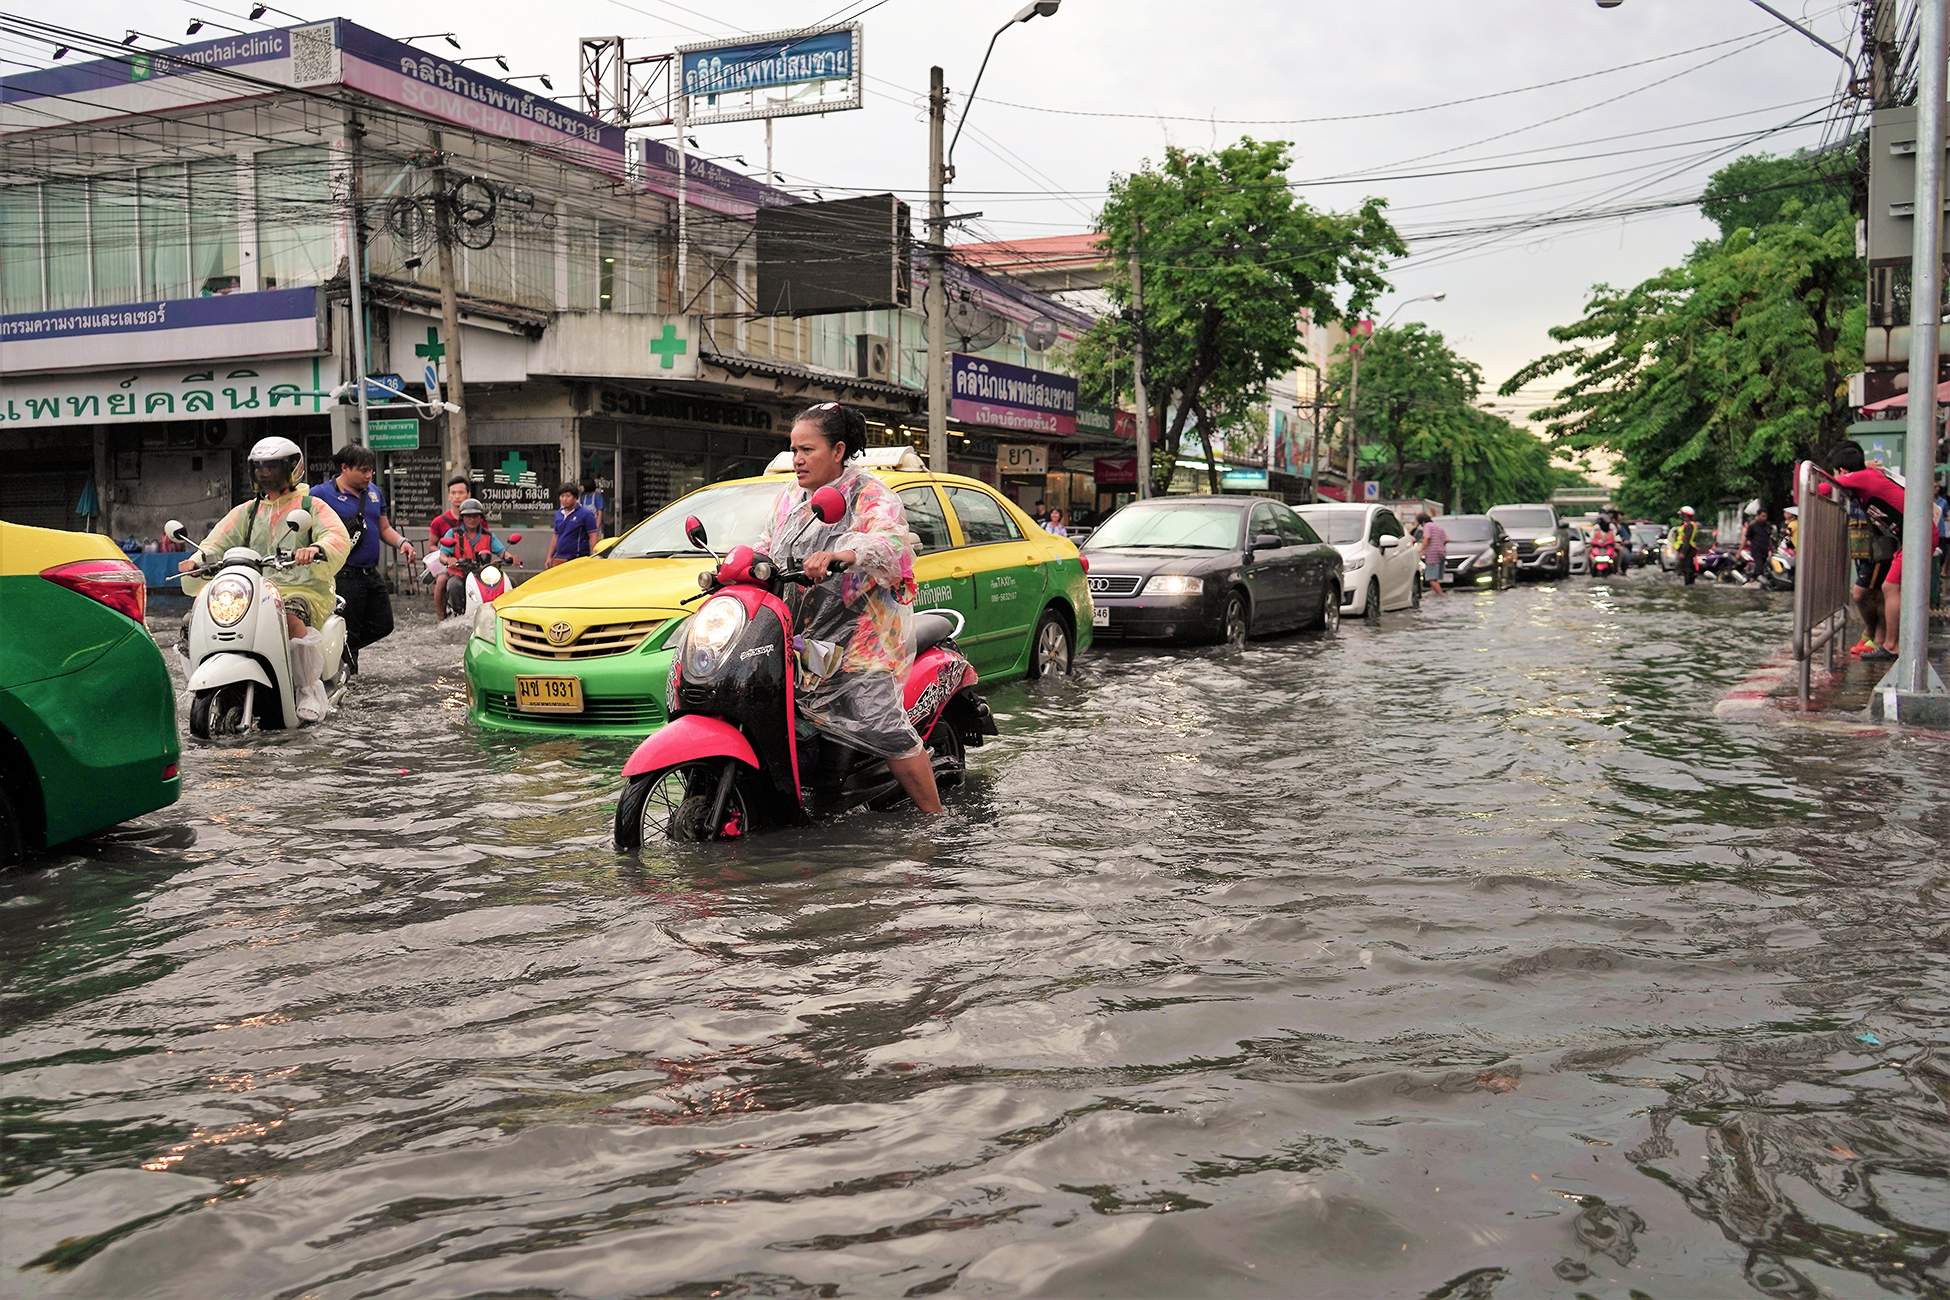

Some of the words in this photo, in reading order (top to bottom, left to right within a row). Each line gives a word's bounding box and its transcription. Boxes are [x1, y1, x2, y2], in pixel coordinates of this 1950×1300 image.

[686, 44, 848, 92] คลินิกแพทย์สมชาย
[400, 56, 601, 144] คลินิกแพทย์สมชาย
[401, 80, 521, 139] SOMCHAI
[691, 158, 705, 178] 24
[0, 303, 166, 335] กรรมความงามและเลเซอร์
[386, 378, 399, 390] 36
[956, 361, 1075, 411] คลินิกแพทย์สมชาย
[545, 681, 574, 698] 1931
